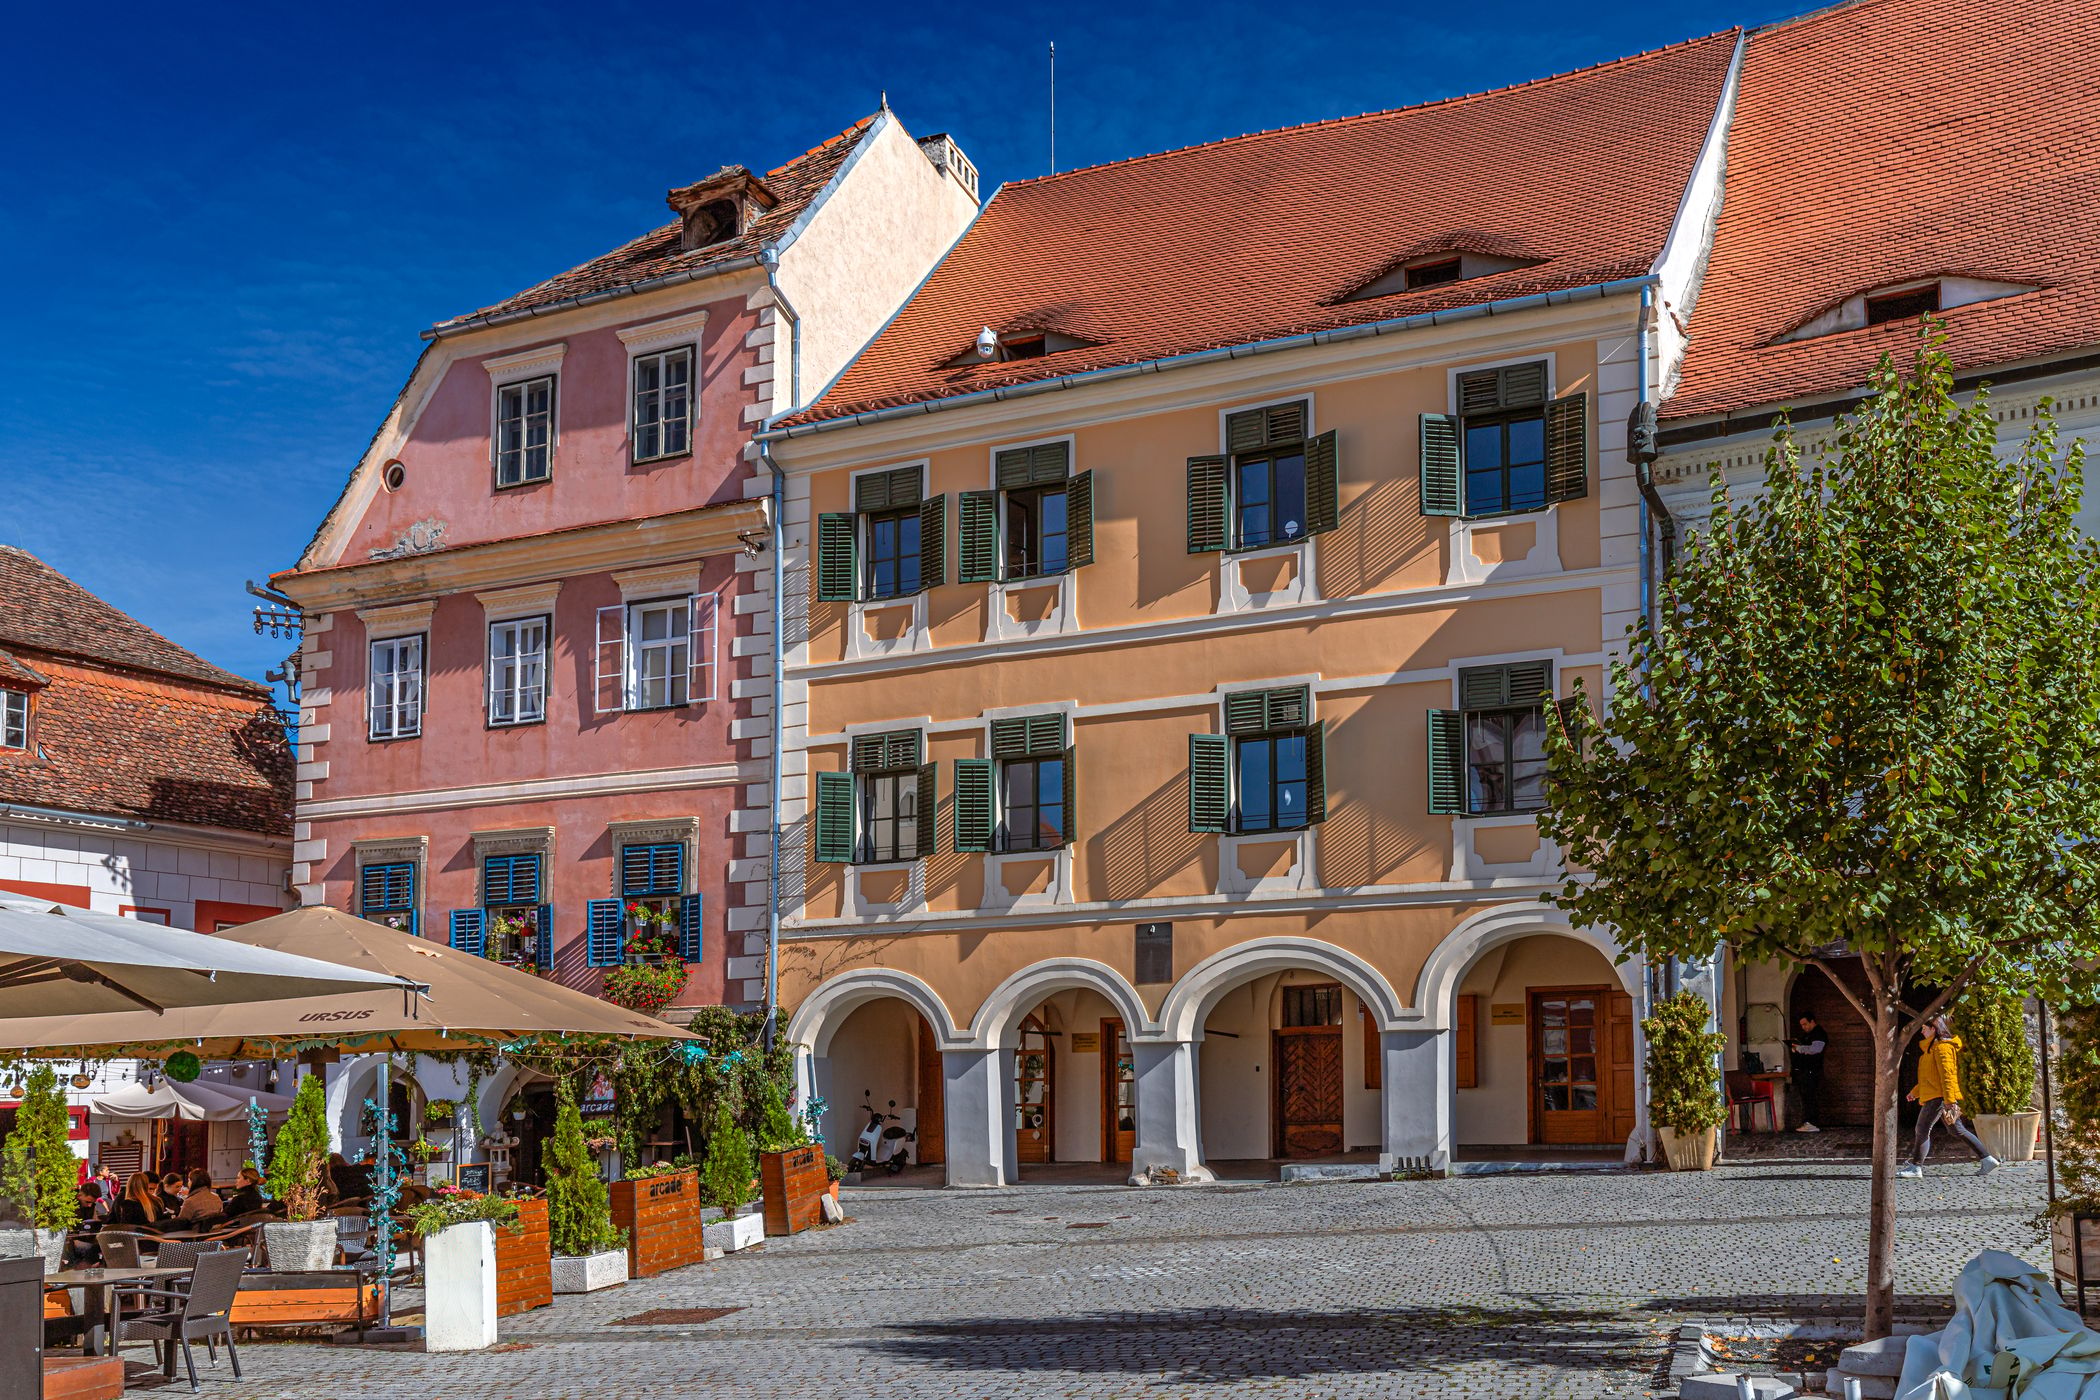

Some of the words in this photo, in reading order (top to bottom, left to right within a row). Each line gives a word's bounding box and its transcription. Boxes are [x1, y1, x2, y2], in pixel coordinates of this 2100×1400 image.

[299, 1010, 374, 1022] URSUS
[580, 1101, 615, 1112] arcade
[650, 1176, 682, 1197] arcade
